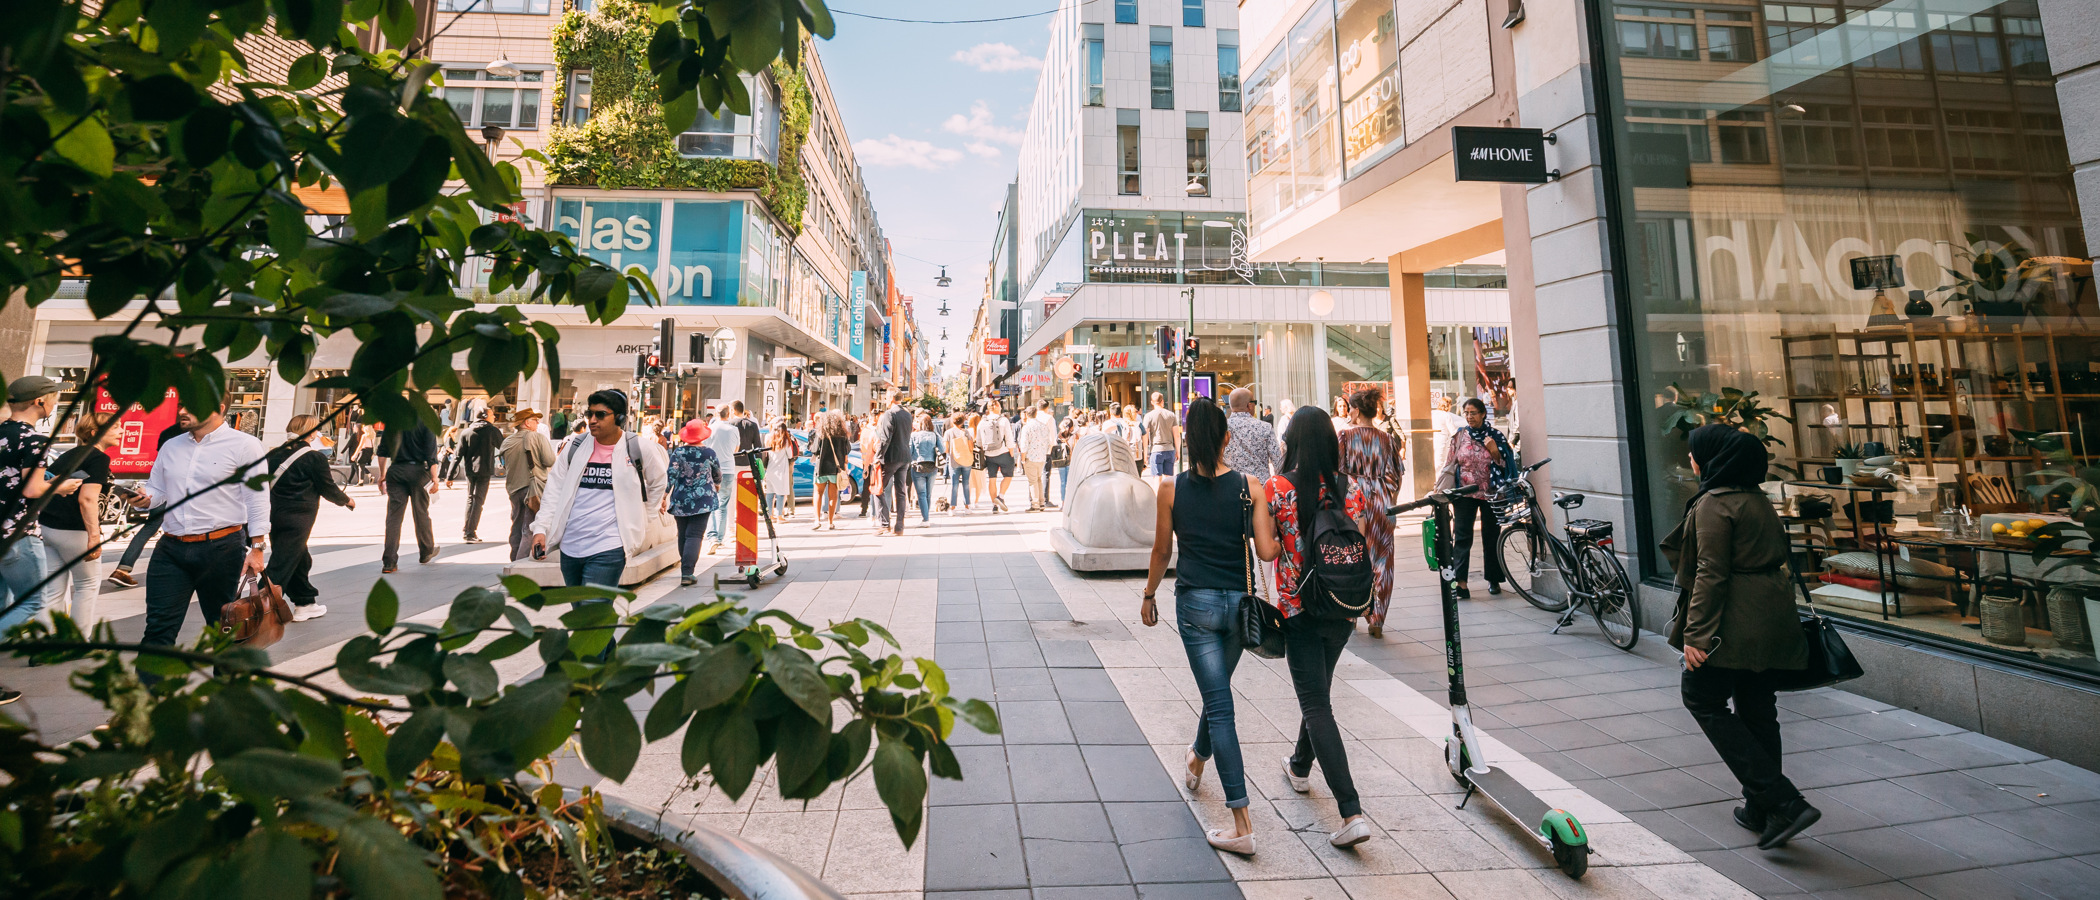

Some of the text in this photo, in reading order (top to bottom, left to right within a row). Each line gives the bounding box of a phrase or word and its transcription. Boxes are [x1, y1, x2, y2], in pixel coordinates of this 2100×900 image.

[1489, 147, 1533, 162] HOME
[560, 206, 652, 251] clas
[1091, 231, 1189, 261] PLEAT
[852, 285, 864, 346] clas ohlson
[616, 345, 653, 354] ARKET
[883, 322, 891, 365] INTERSPORT
[1107, 351, 1130, 370] H&M
[589, 467, 612, 477] DIES
[597, 477, 612, 485] DIVIS
